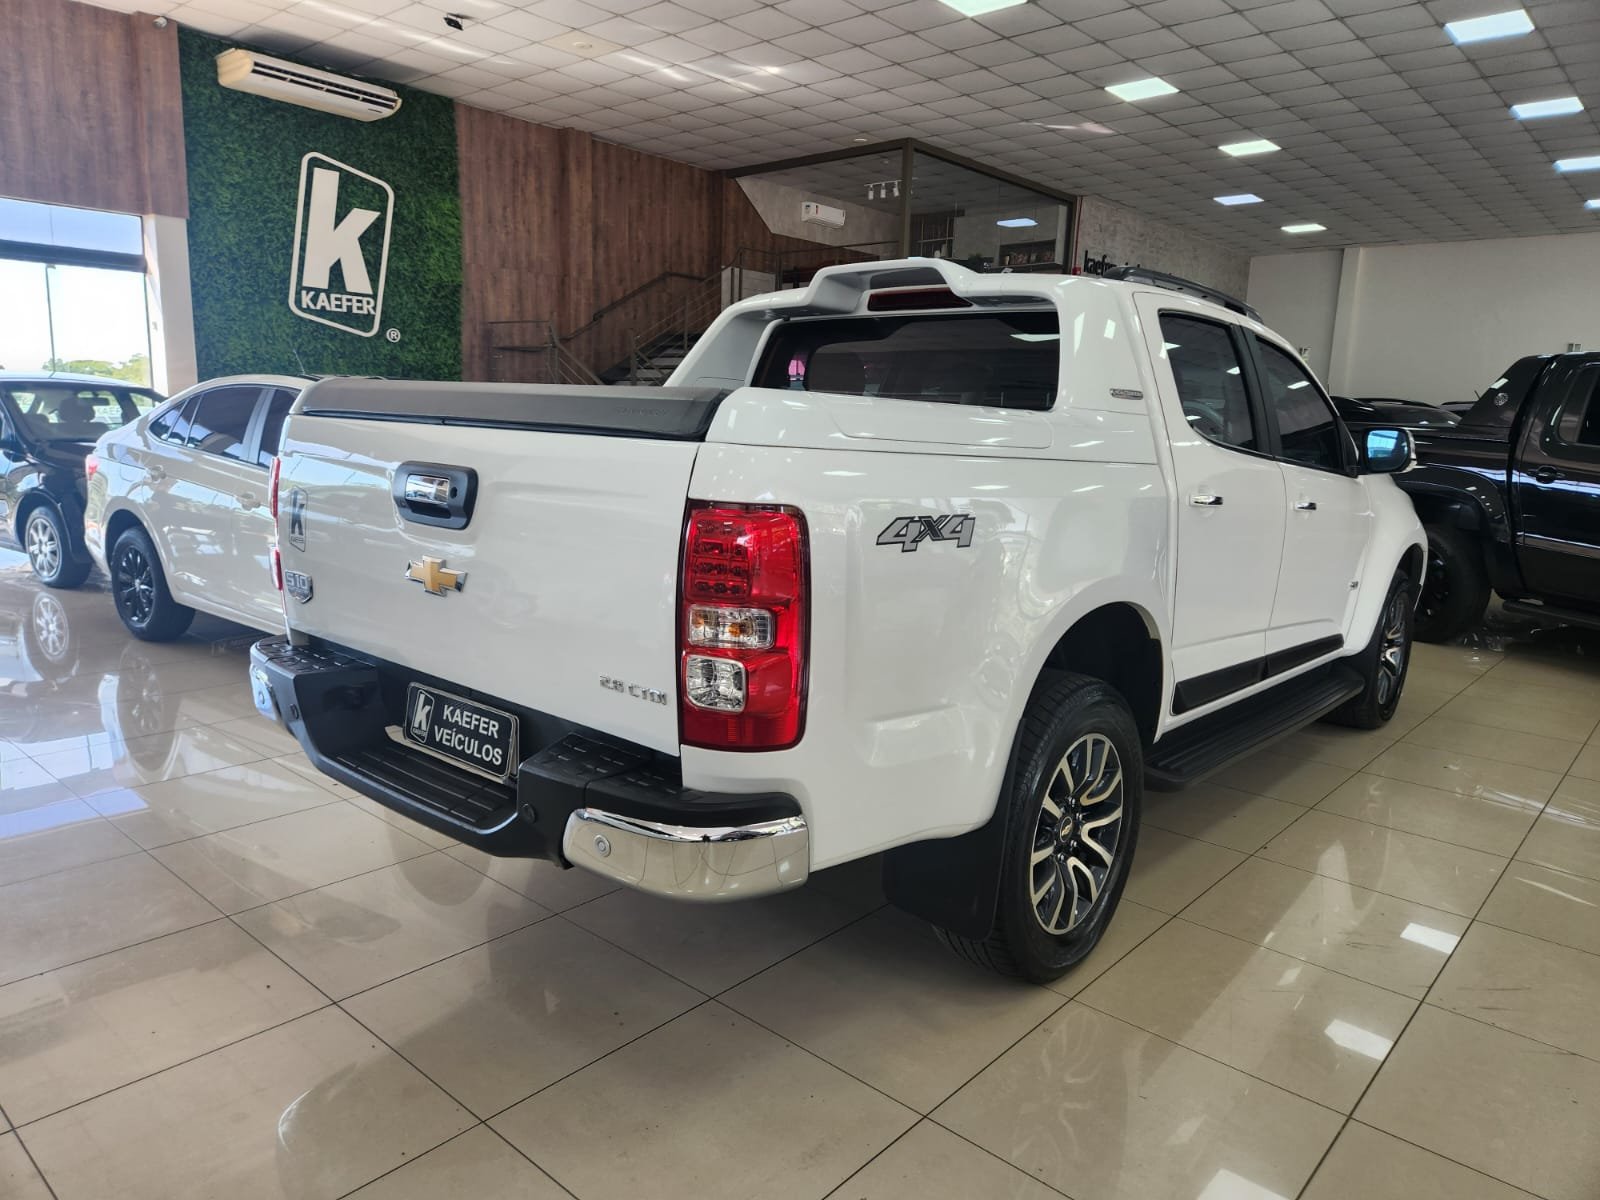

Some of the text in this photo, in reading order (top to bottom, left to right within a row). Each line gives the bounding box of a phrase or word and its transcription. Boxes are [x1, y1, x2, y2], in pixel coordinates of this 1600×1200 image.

[301, 290, 376, 315] KAEFER
[443, 704, 499, 739] KAEFER
[434, 724, 503, 766] VEÍCULOS
